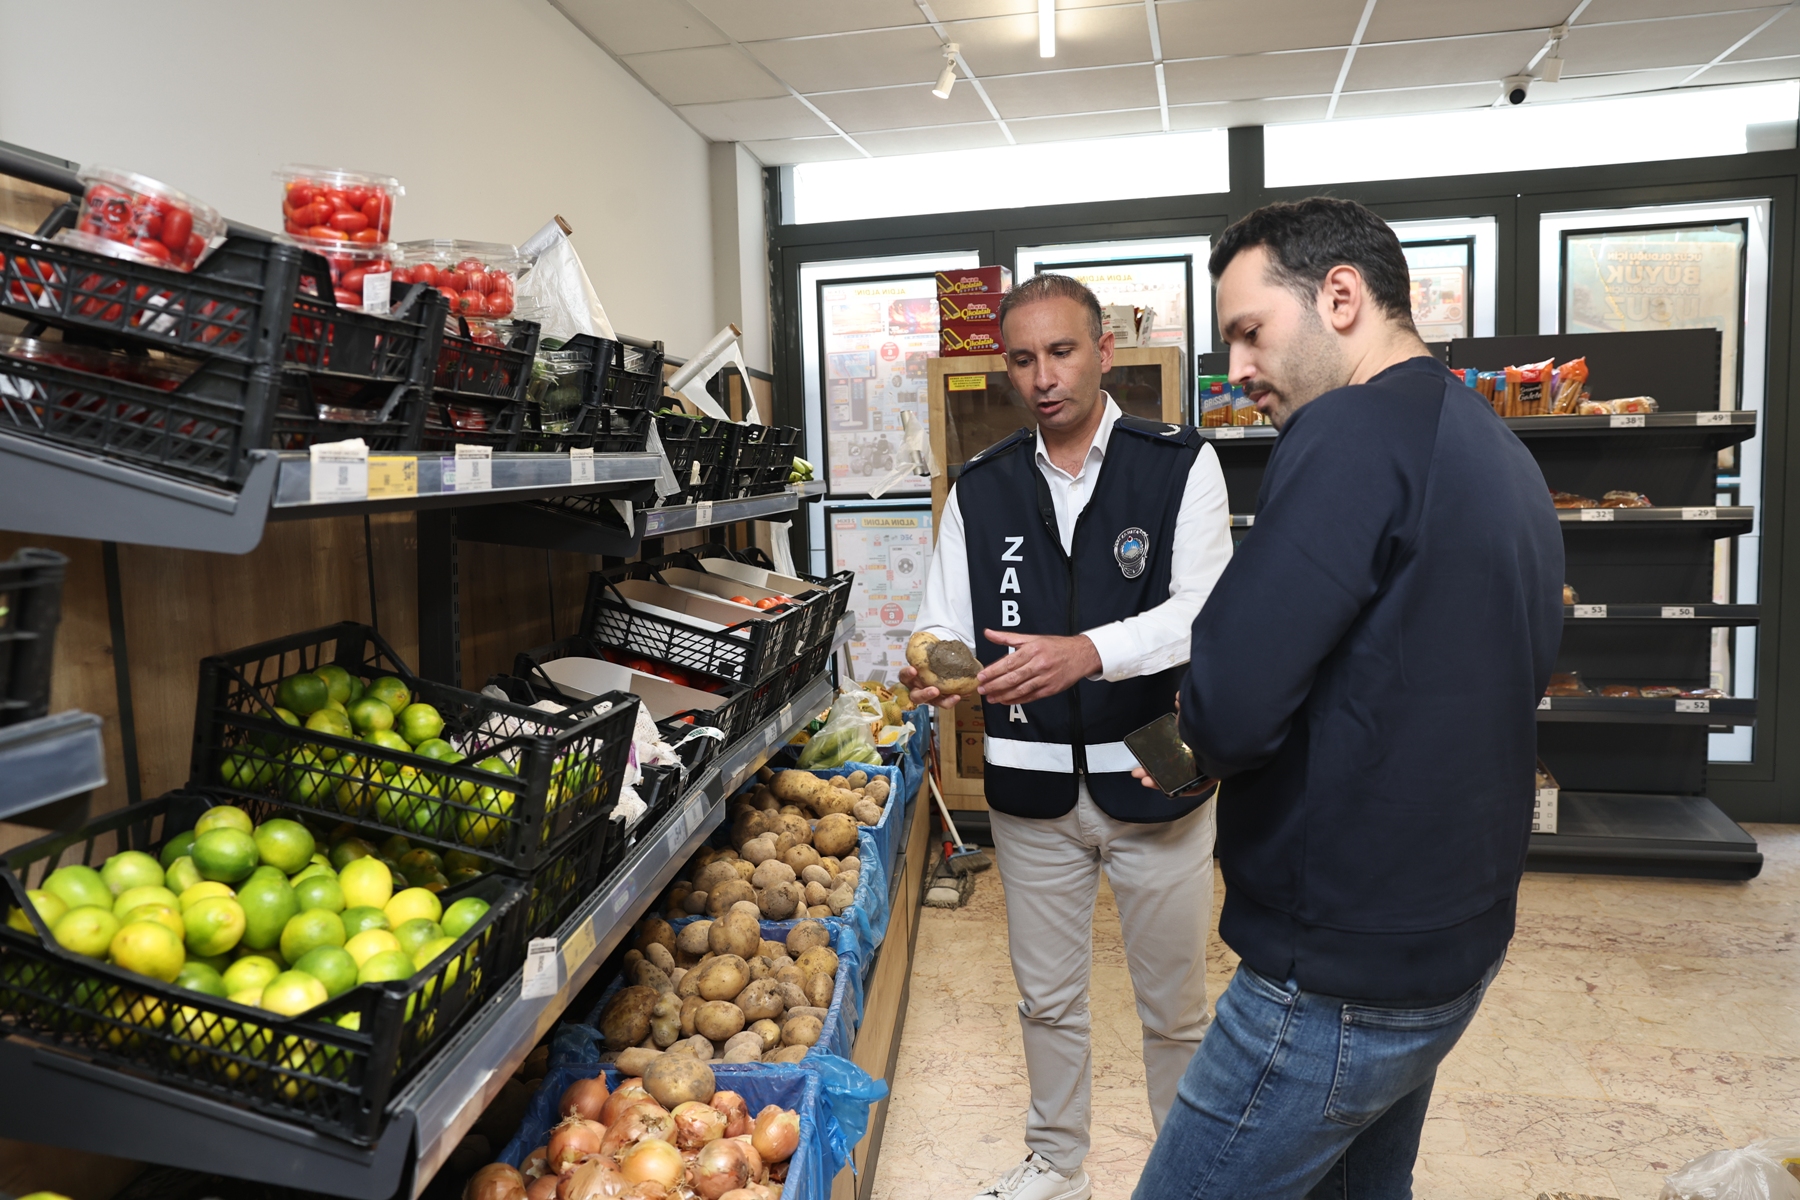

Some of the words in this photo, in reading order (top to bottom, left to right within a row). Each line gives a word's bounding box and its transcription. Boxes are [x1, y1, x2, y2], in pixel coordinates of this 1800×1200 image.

[1625, 416, 1637, 425] 38
[1712, 414, 1724, 422] 49
[1595, 511, 1607, 519] 32
[1591, 606, 1602, 614] 53
[1679, 608, 1690, 616] 50
[1000, 536, 1028, 724] ZABA
[1694, 701, 1705, 709] 52
